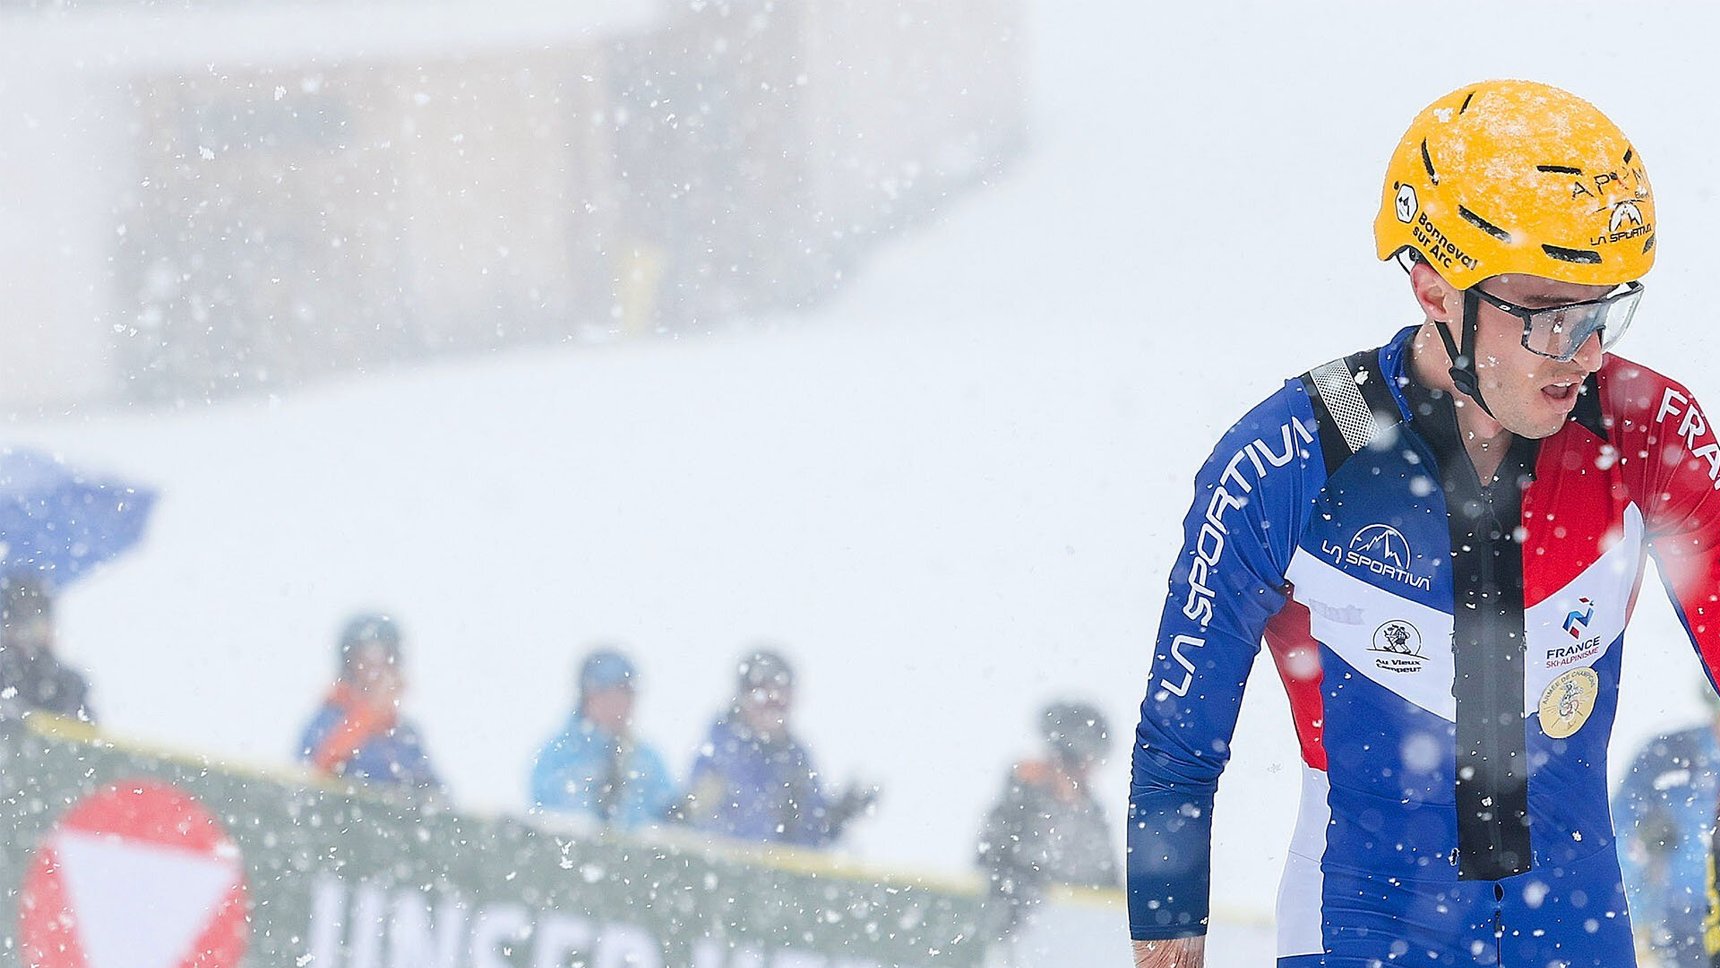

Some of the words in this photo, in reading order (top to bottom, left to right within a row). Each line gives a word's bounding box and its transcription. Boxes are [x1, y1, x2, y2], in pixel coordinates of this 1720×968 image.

[1412, 226, 1431, 247] sur
[1429, 244, 1453, 269] Arc
[1418, 211, 1478, 271] Bonneval
[1590, 236, 1607, 246] LA
[1182, 416, 1314, 627] SPORTIVA
[1321, 539, 1343, 565] LA
[1345, 551, 1432, 592] SPORTIVA
[1161, 634, 1206, 697] LA
[1546, 636, 1601, 660] FRANCE
